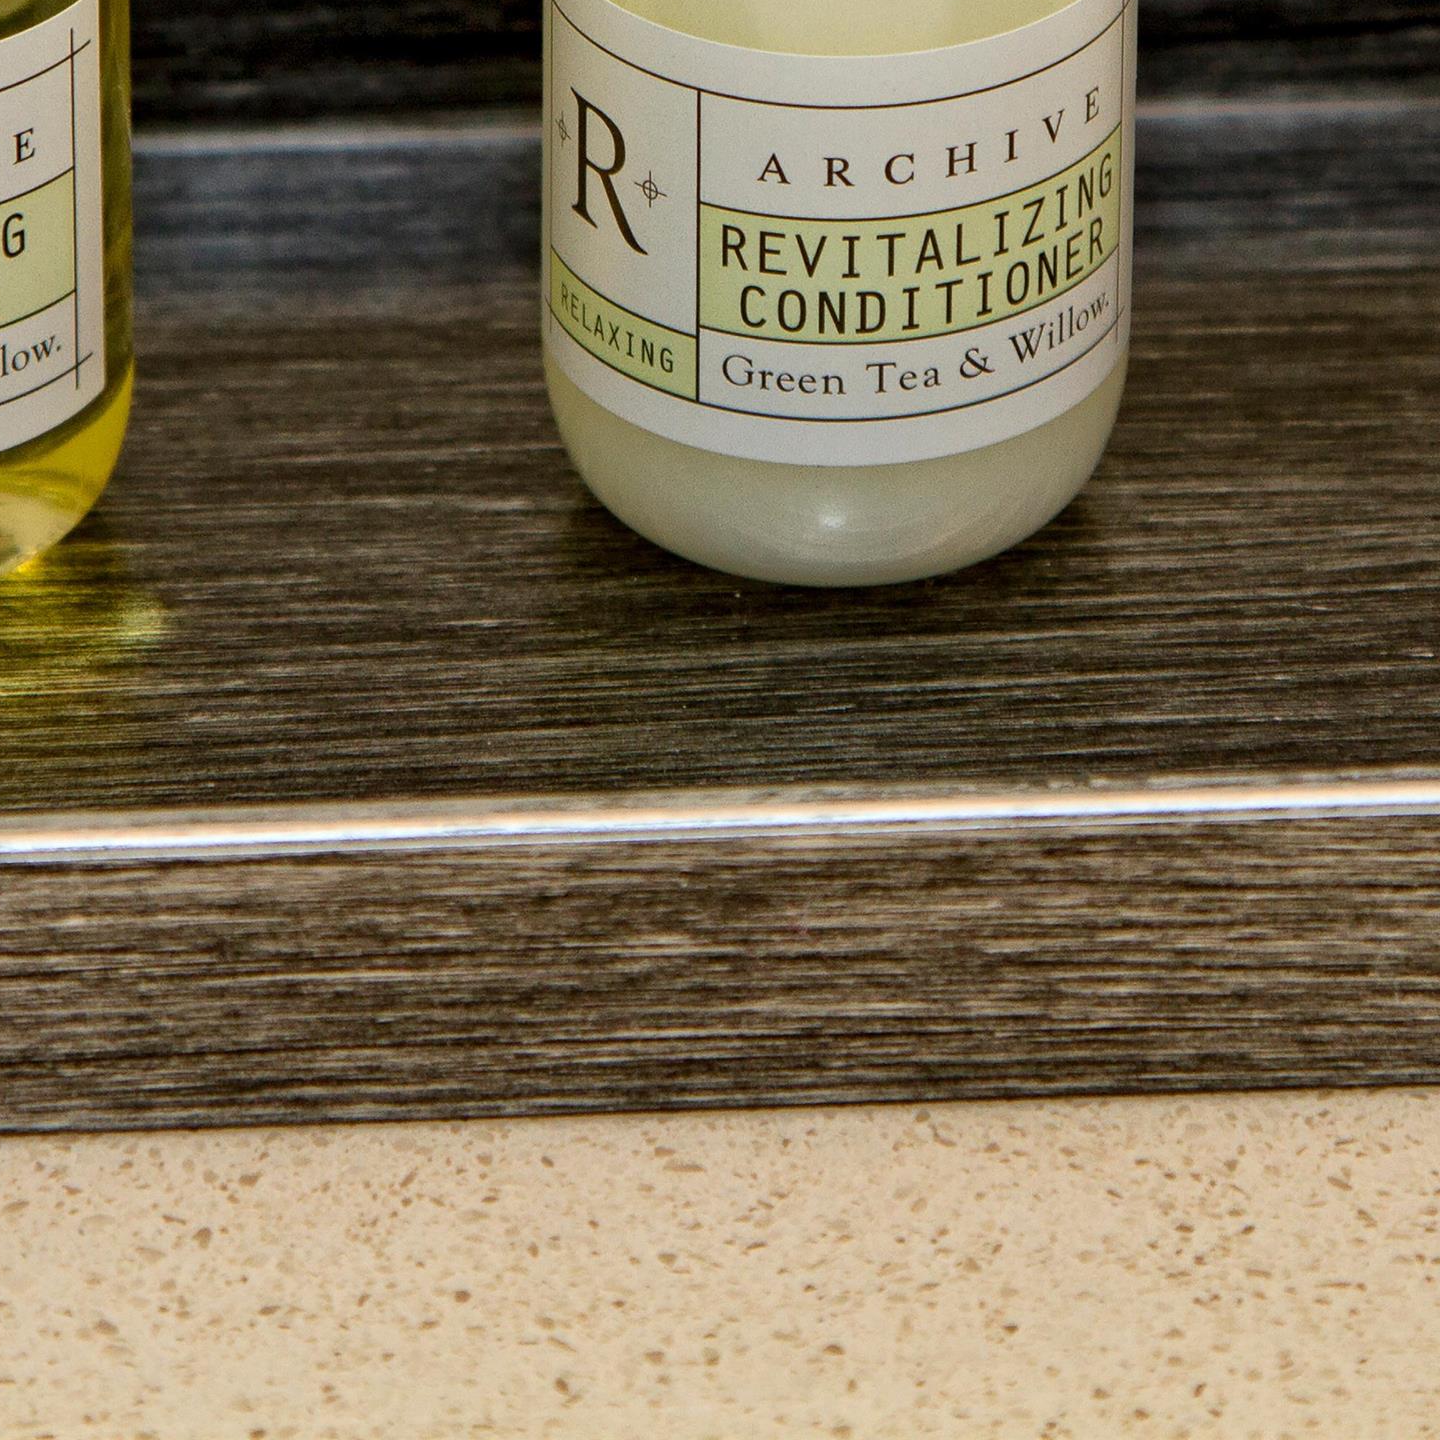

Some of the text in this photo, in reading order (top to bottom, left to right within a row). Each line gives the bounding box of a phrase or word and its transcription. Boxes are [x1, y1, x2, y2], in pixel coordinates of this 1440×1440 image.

[570, 86, 648, 256] R
[757, 87, 1100, 188] ARCHIVE
[721, 152, 1113, 280] REVITALIZING
[560, 283, 675, 374] RELAXING
[741, 220, 1104, 335] CONDITIONER
[722, 355, 847, 396] Green
[867, 361, 942, 394] Tea
[959, 347, 996, 379] &
